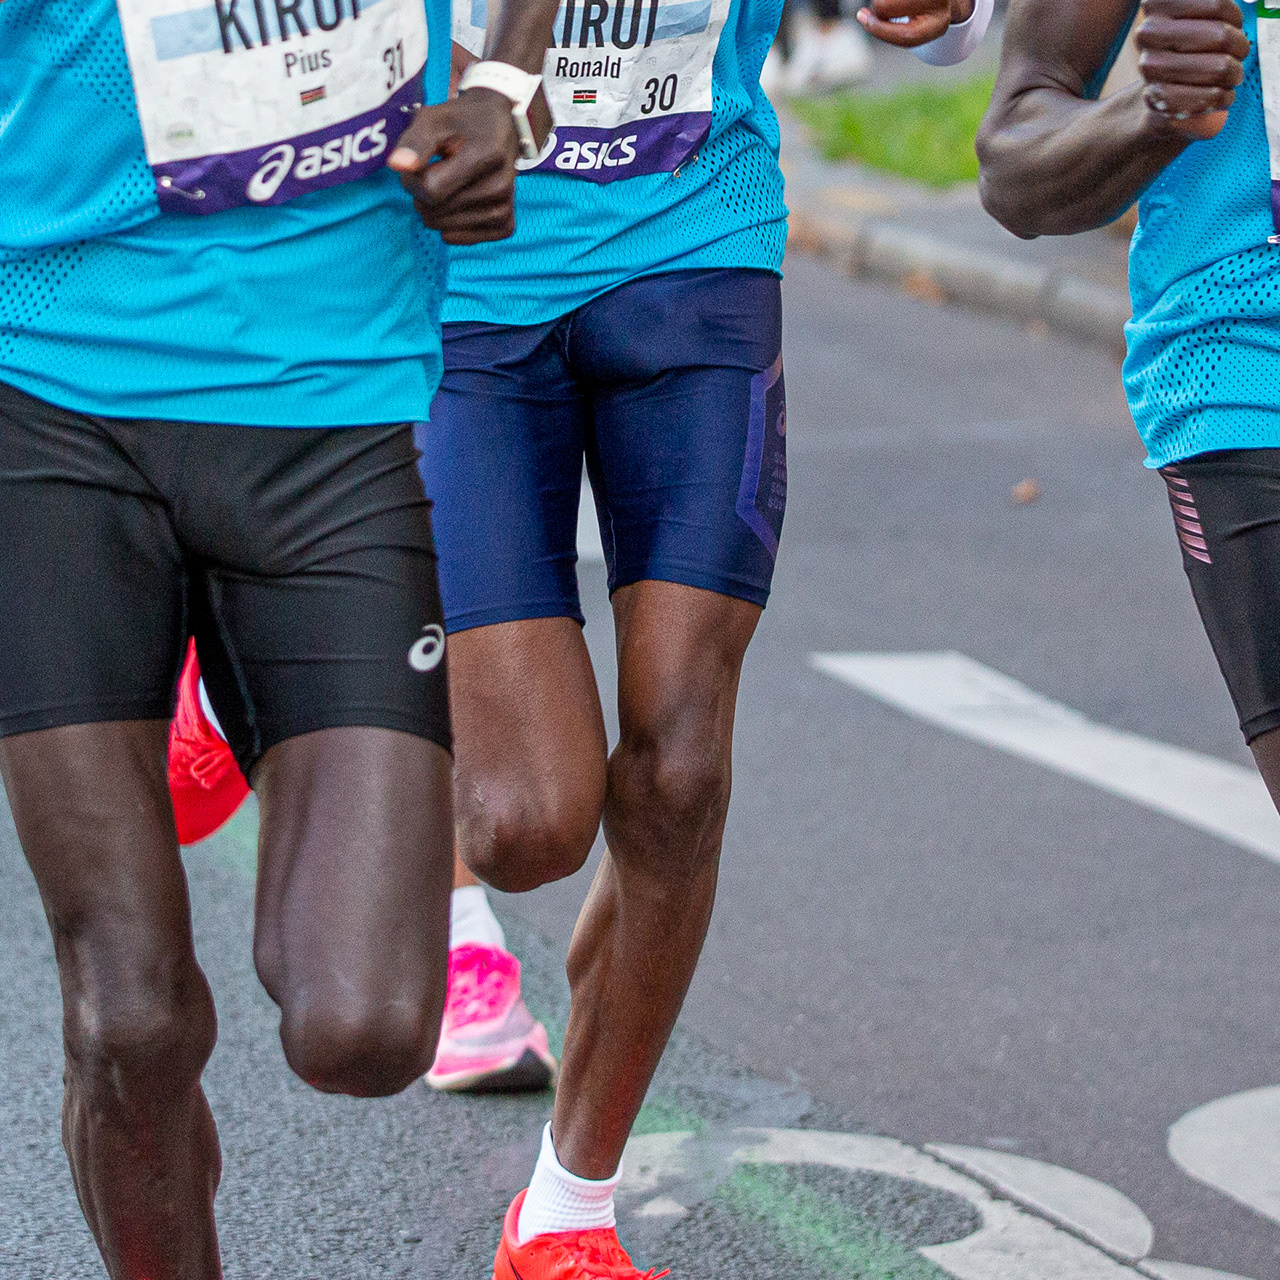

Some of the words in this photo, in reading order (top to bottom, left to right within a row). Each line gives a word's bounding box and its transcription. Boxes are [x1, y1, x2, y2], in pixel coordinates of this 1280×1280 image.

[284, 48, 332, 78] Pius
[383, 38, 405, 90] 31
[555, 55, 622, 79] Ronald
[641, 74, 677, 114] 30
[294, 119, 387, 180] asics
[555, 134, 637, 169] asics
